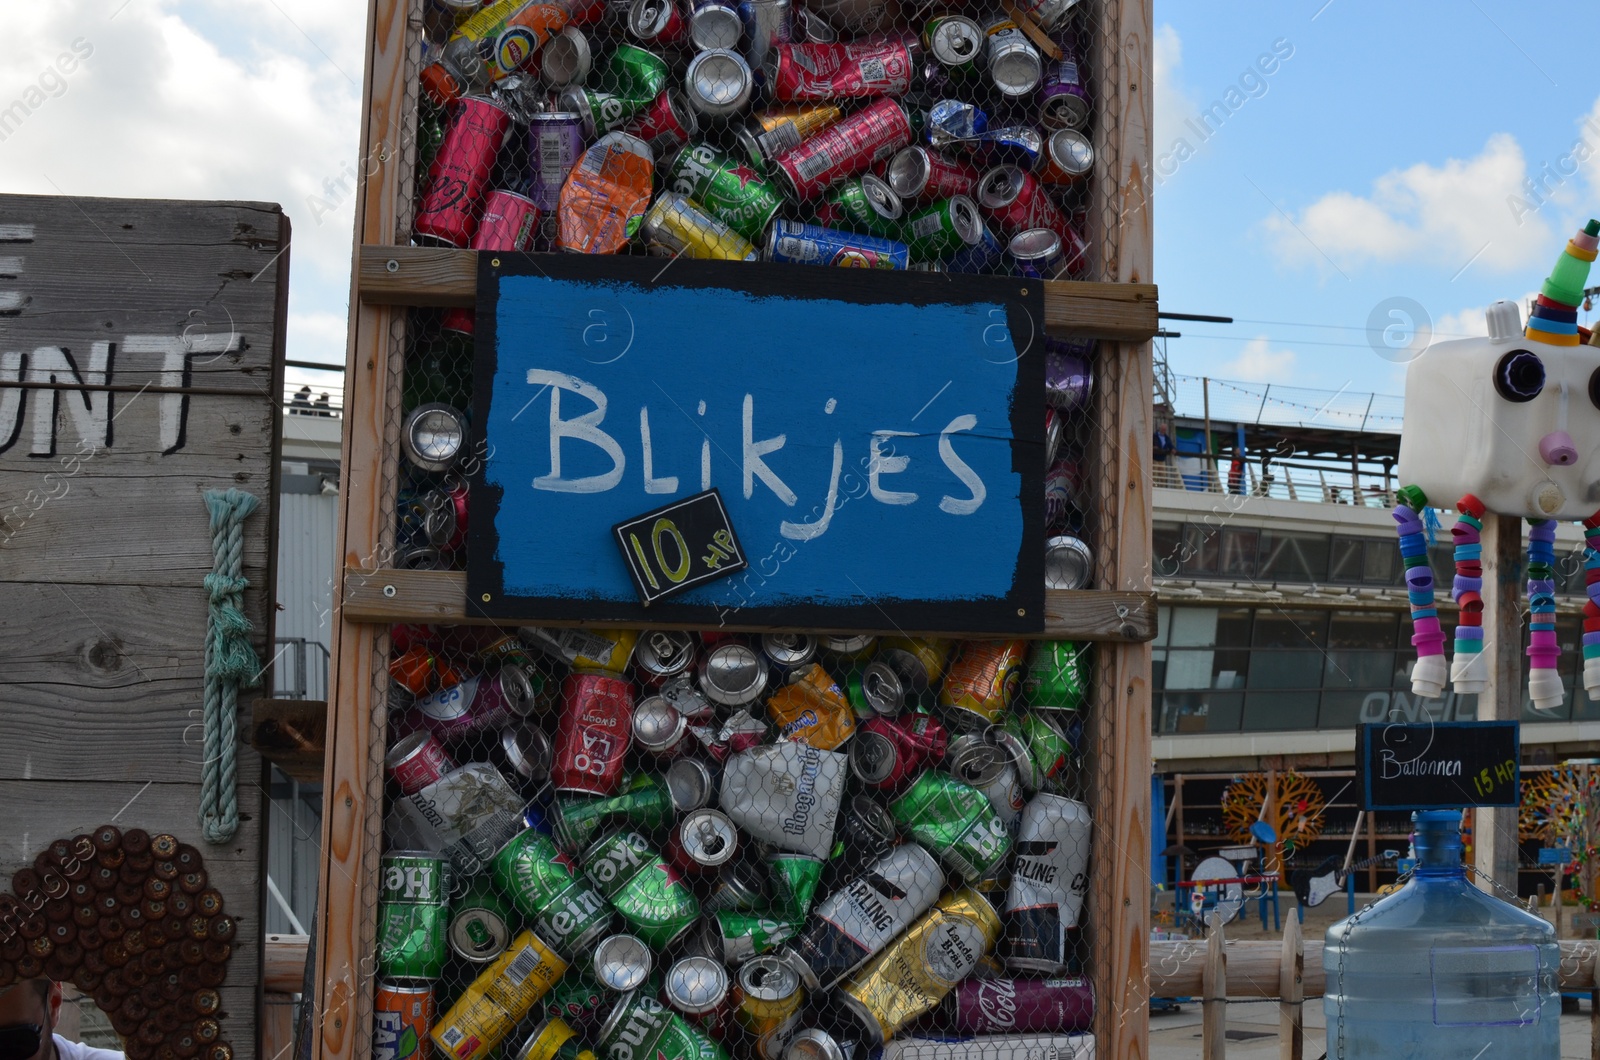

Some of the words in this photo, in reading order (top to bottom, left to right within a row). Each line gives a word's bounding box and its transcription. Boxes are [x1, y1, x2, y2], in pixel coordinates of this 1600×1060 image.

[507, 40, 522, 64] Lipton
[629, 518, 690, 590] 10
[701, 528, 735, 569] HP
[582, 713, 617, 728] gwoon
[583, 731, 612, 757] LA
[574, 753, 606, 776] CO
[1379, 749, 1462, 780] Ballonnen
[1473, 767, 1494, 797] 15
[1496, 759, 1516, 785] HP
[939, 937, 965, 970] Bräu
[945, 924, 977, 967] Lander
